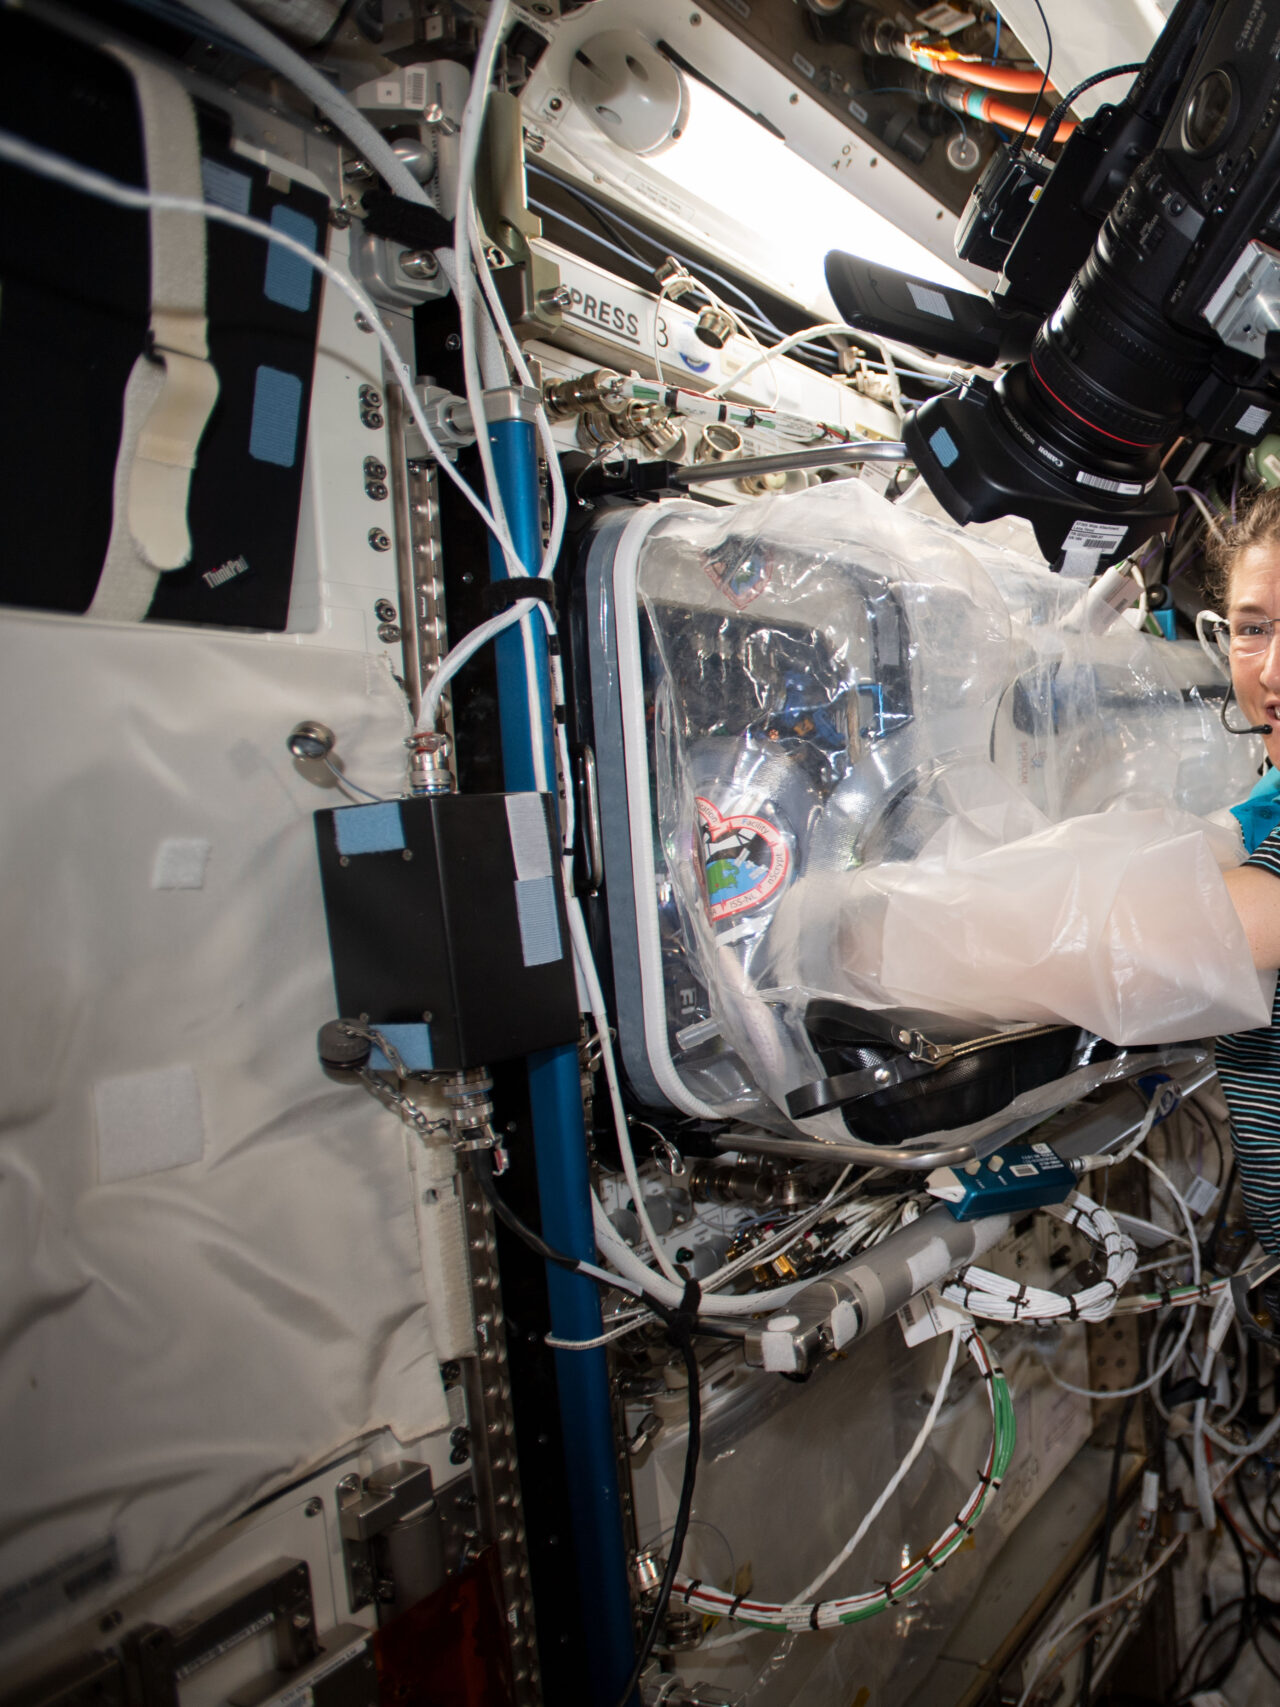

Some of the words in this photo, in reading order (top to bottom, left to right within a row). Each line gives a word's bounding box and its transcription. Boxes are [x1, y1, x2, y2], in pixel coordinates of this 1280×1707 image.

[564, 283, 640, 337] PRESS
[1036, 445, 1065, 468] Canon
[200, 554, 249, 590] ThinkPad
[741, 818, 770, 835] Facility
[766, 852, 784, 886] nScrypt
